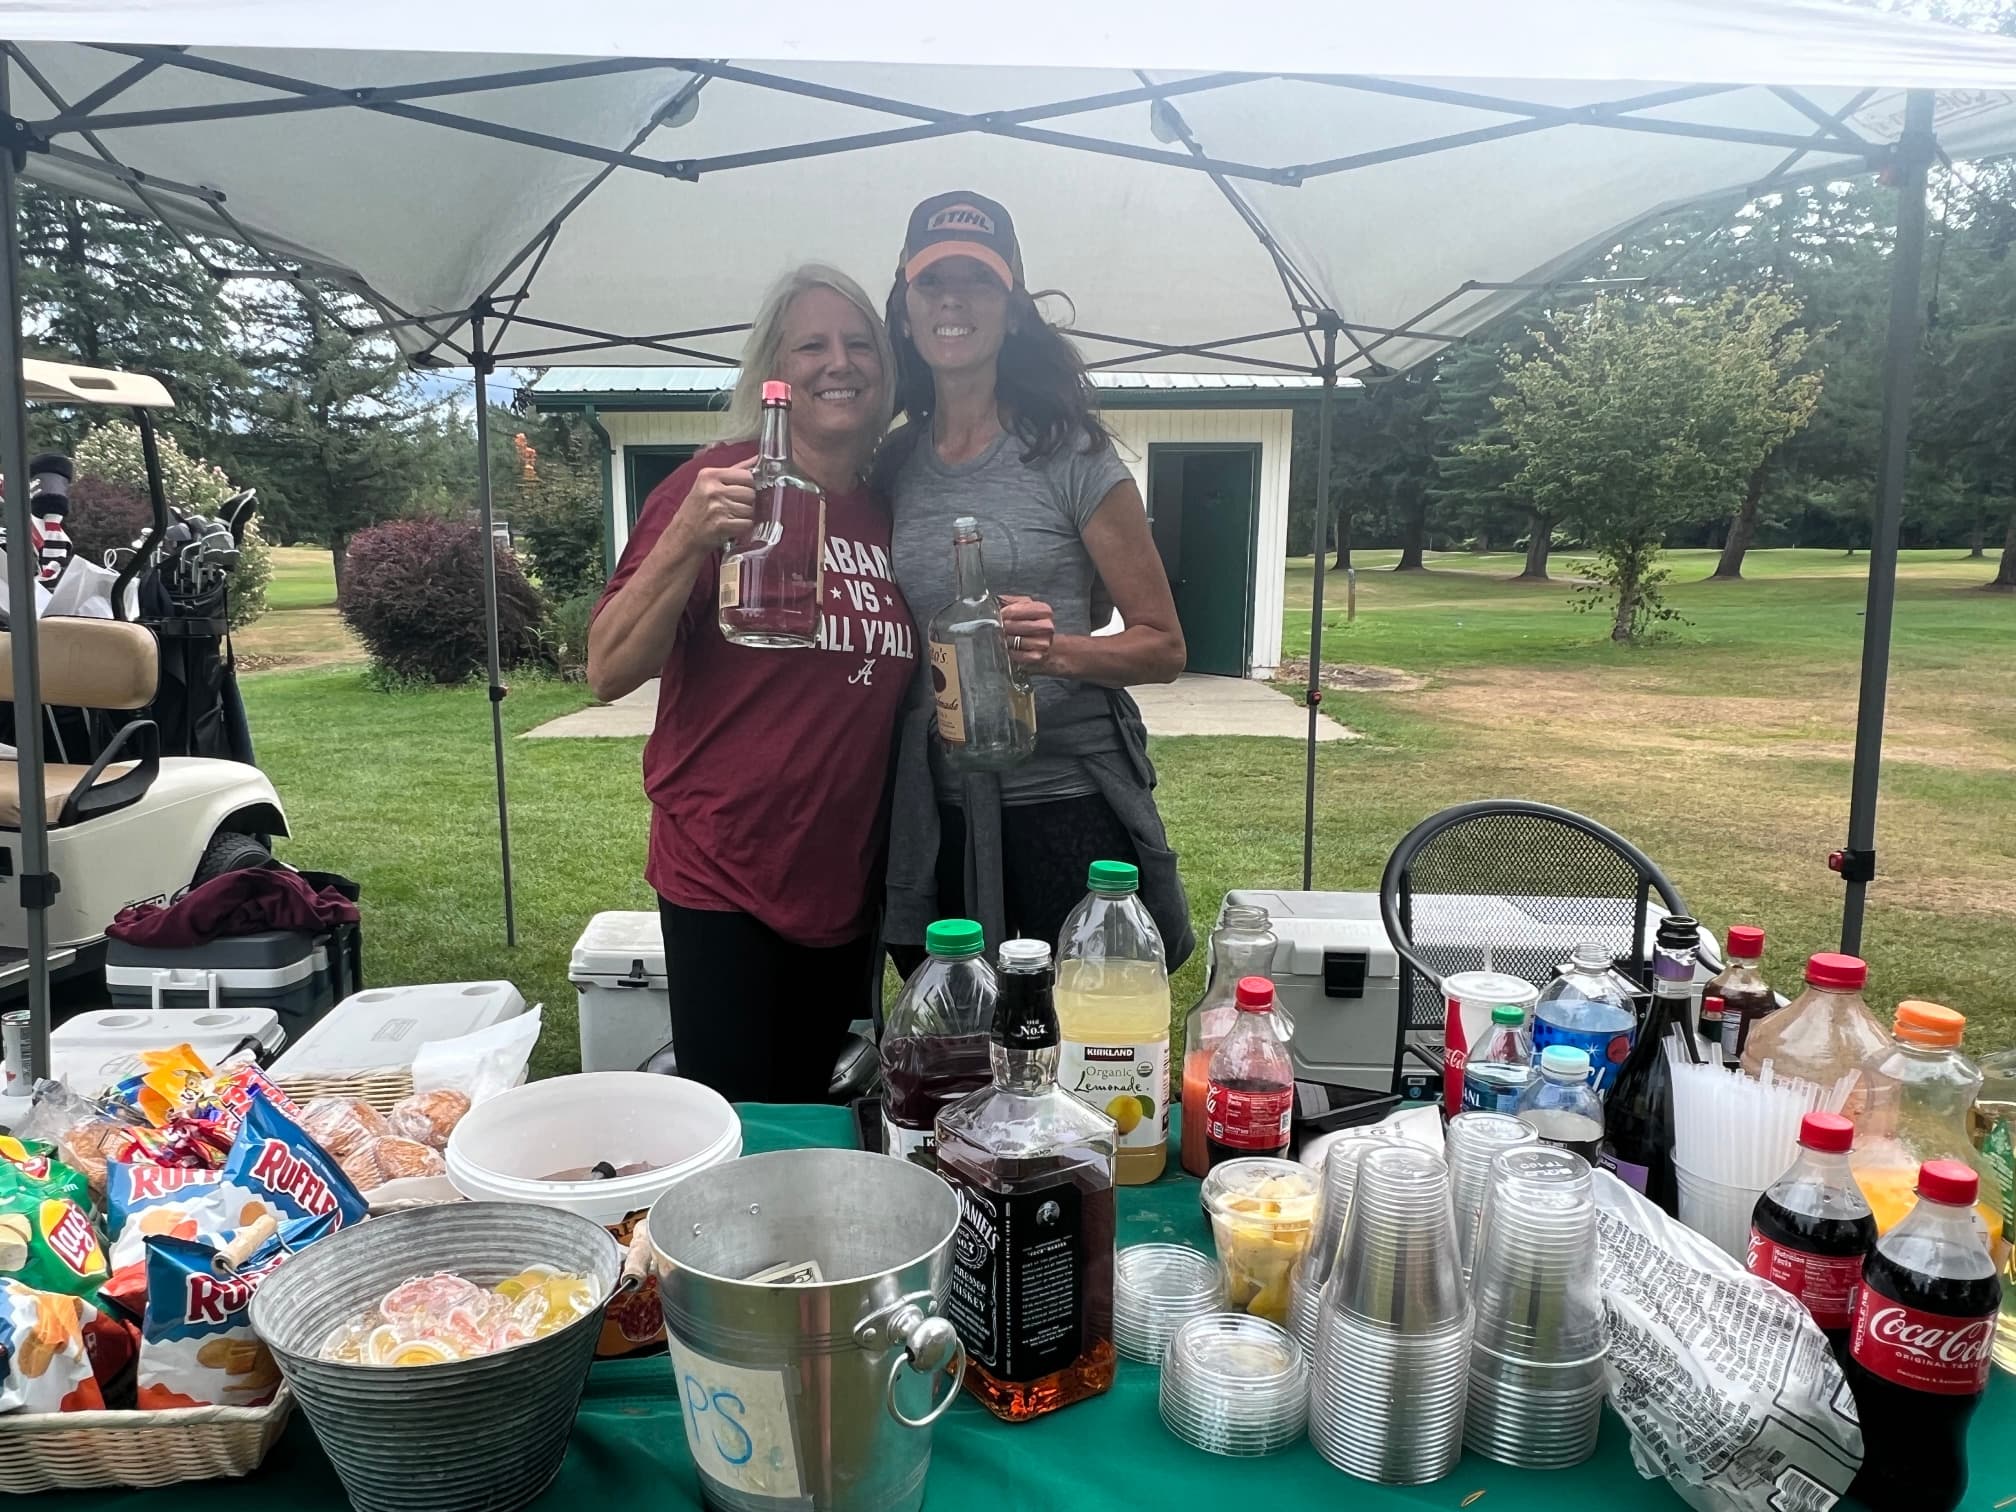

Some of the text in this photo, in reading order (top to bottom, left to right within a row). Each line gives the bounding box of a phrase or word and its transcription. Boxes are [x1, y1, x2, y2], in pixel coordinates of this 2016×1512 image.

[932, 209, 990, 231] STIHL
[823, 536, 896, 585] ABAM
[844, 578, 881, 613] VS
[814, 612, 914, 660] ALL Y'ALL
[1087, 1047, 1133, 1057] KIRKLAND
[1073, 1069, 1143, 1095] Lemonade
[1085, 1065, 1133, 1080] Organic
[953, 1264, 987, 1293] nnessee
[952, 1280, 987, 1313] HISKEY
[1853, 1307, 1866, 1354] RECYCLE
[1895, 1350, 1948, 1369] ORIGINAL
